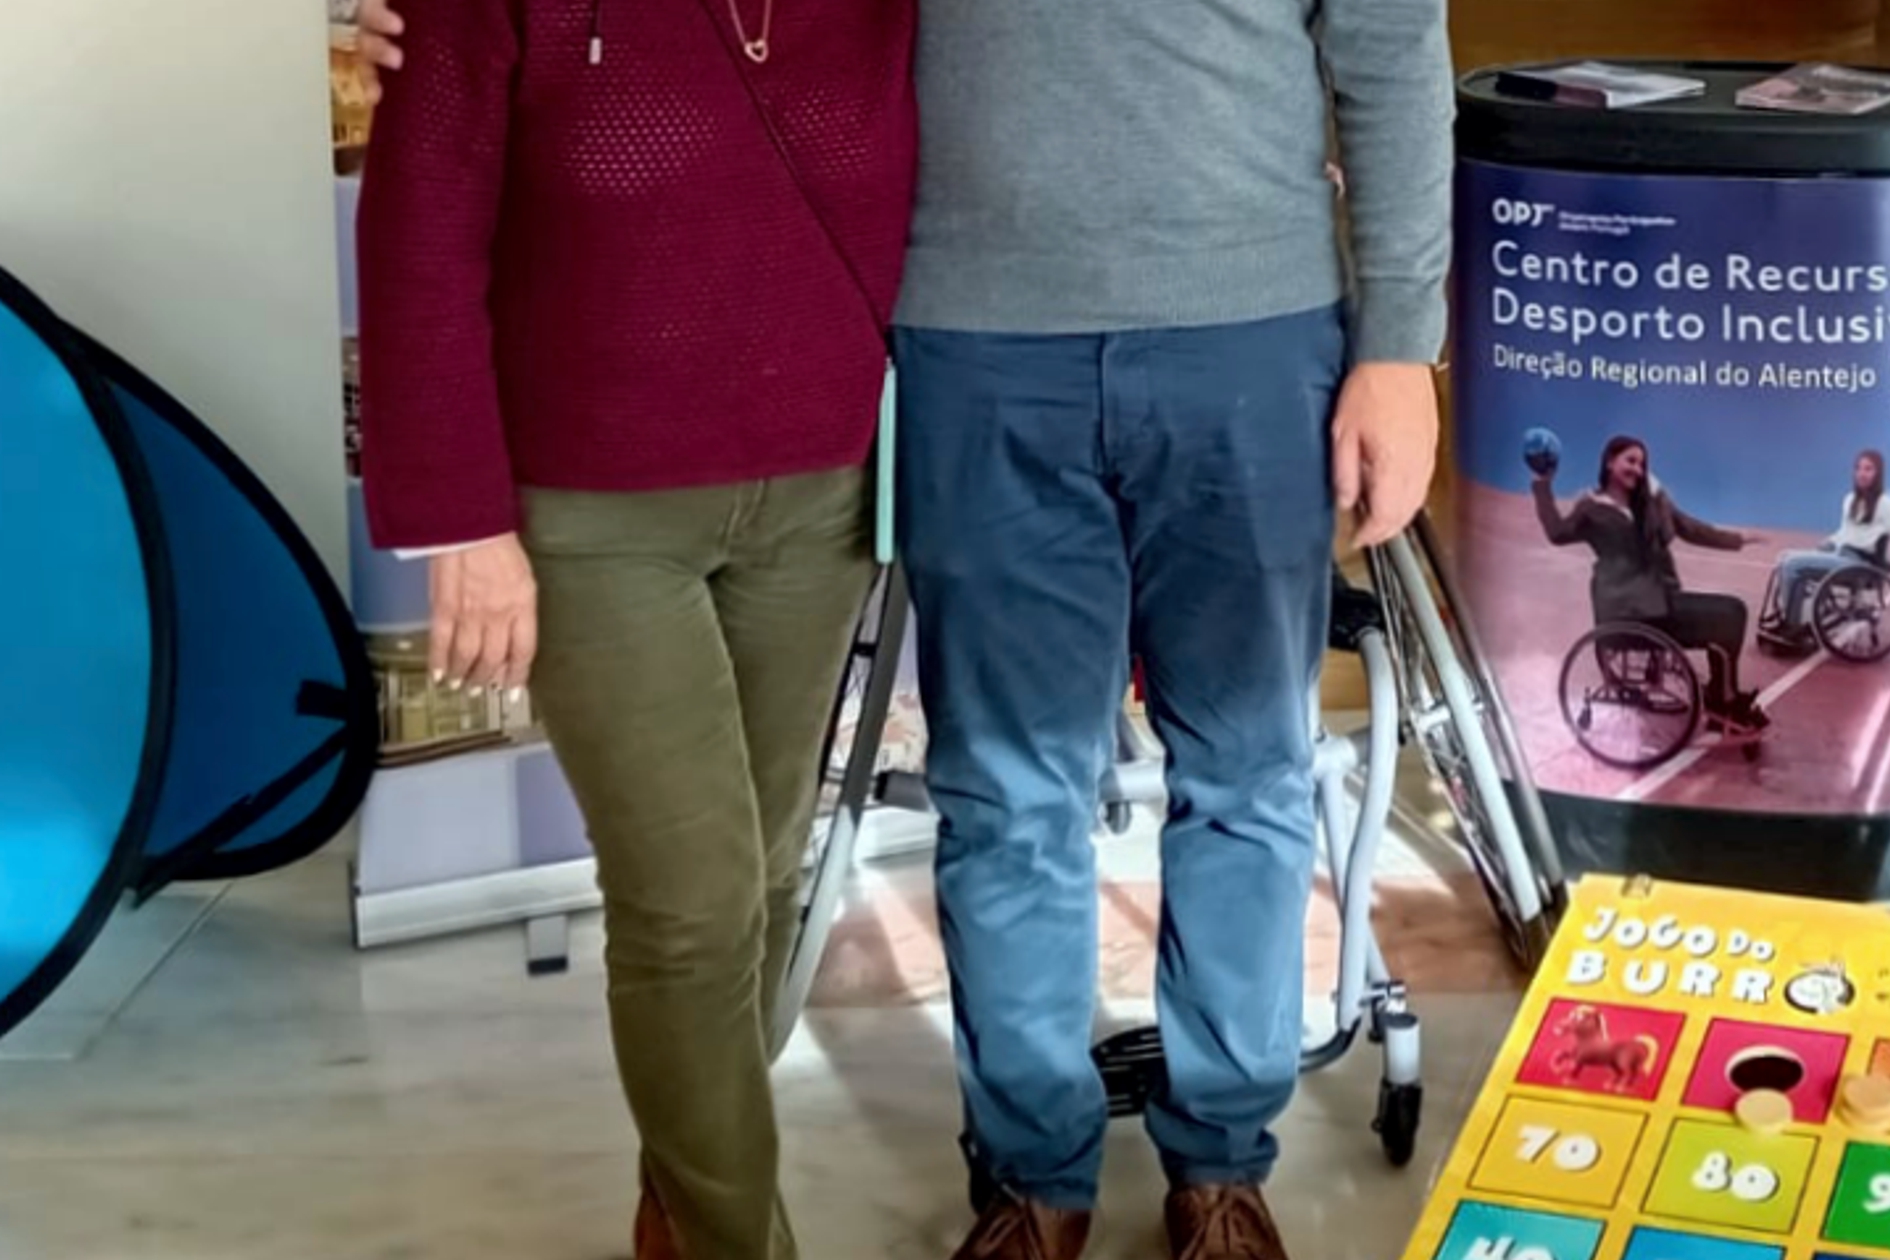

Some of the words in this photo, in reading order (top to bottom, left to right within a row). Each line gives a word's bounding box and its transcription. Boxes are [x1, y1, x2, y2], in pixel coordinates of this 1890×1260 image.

[1492, 240, 1638, 289] Centro
[1654, 253, 1710, 291] de
[1492, 287, 1705, 345] Desporto
[1493, 345, 1583, 381] Direção
[1592, 355, 1706, 389] Regional
[1715, 362, 1750, 389] do
[1758, 362, 1877, 394] Alentejo
[1517, 1123, 1600, 1171] 70
[1691, 1151, 1779, 1202] 80
